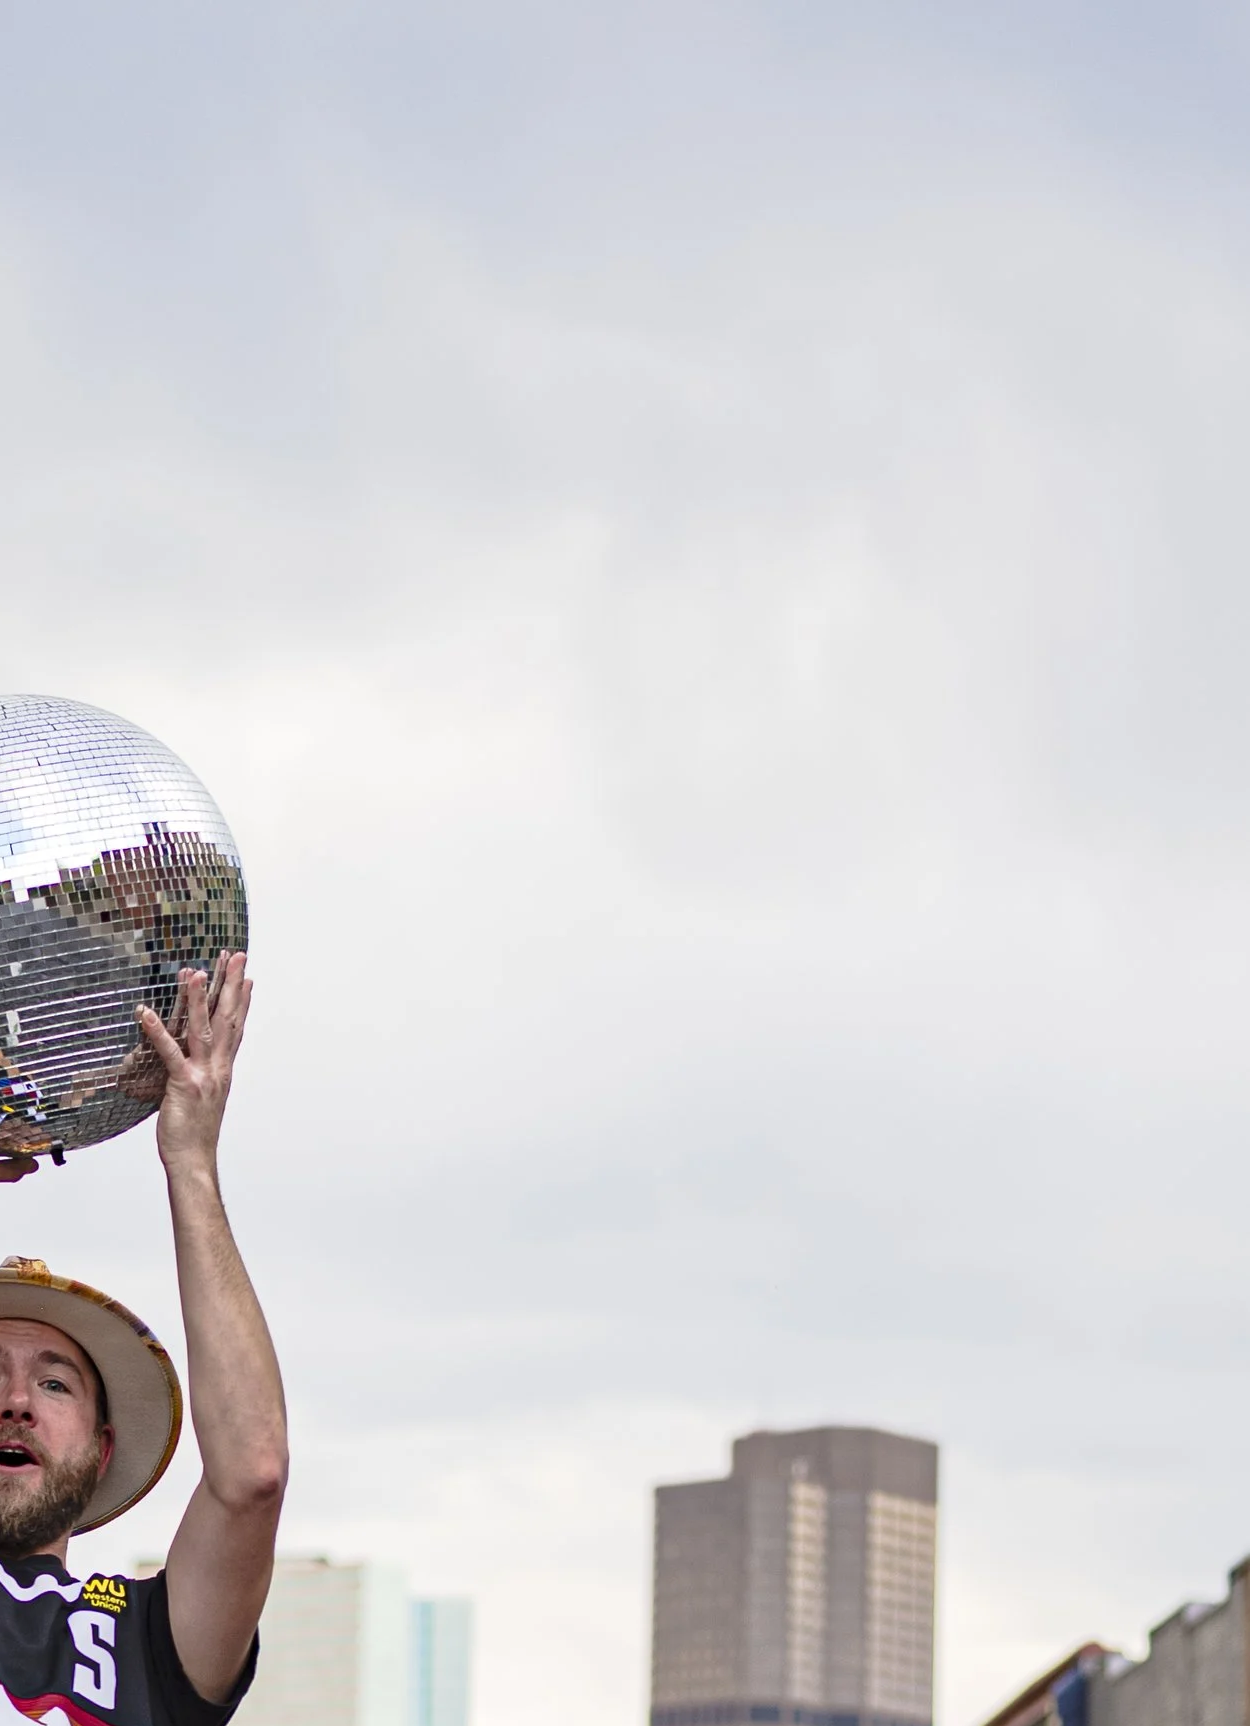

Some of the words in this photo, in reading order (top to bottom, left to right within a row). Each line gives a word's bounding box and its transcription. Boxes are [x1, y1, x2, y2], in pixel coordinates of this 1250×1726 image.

[84, 1579, 126, 1598] WU
[82, 1593, 127, 1608] Western
[91, 1600, 121, 1613] Union
